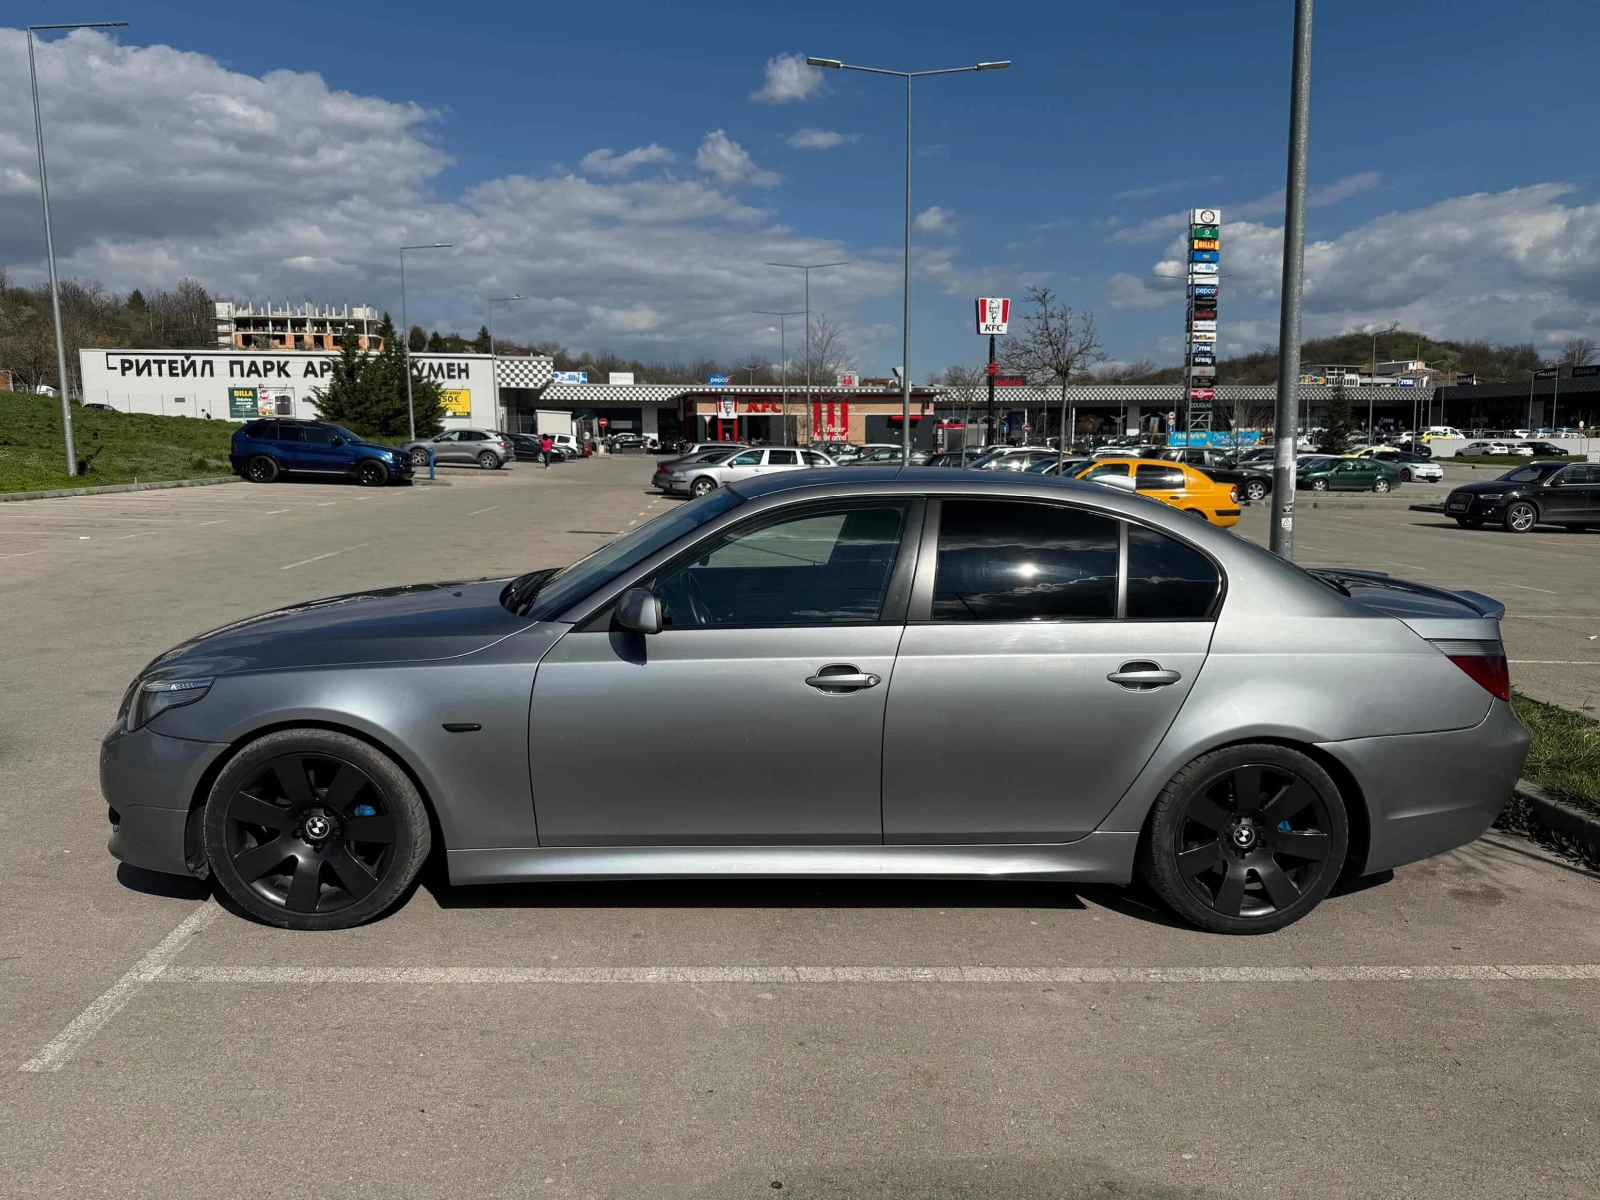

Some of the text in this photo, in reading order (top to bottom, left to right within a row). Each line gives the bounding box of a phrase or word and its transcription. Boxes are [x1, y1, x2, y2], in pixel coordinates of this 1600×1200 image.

[1195, 287, 1216, 295] pepco
[984, 324, 1003, 332] KFC
[1195, 356, 1212, 365] sinsay
[120, 355, 215, 378] РИТЕЙЛ
[229, 359, 292, 378] ПАРК
[414, 361, 470, 380] УМЕН
[746, 401, 783, 413] KFC
[827, 423, 846, 436] finger
[832, 432, 849, 441] good
